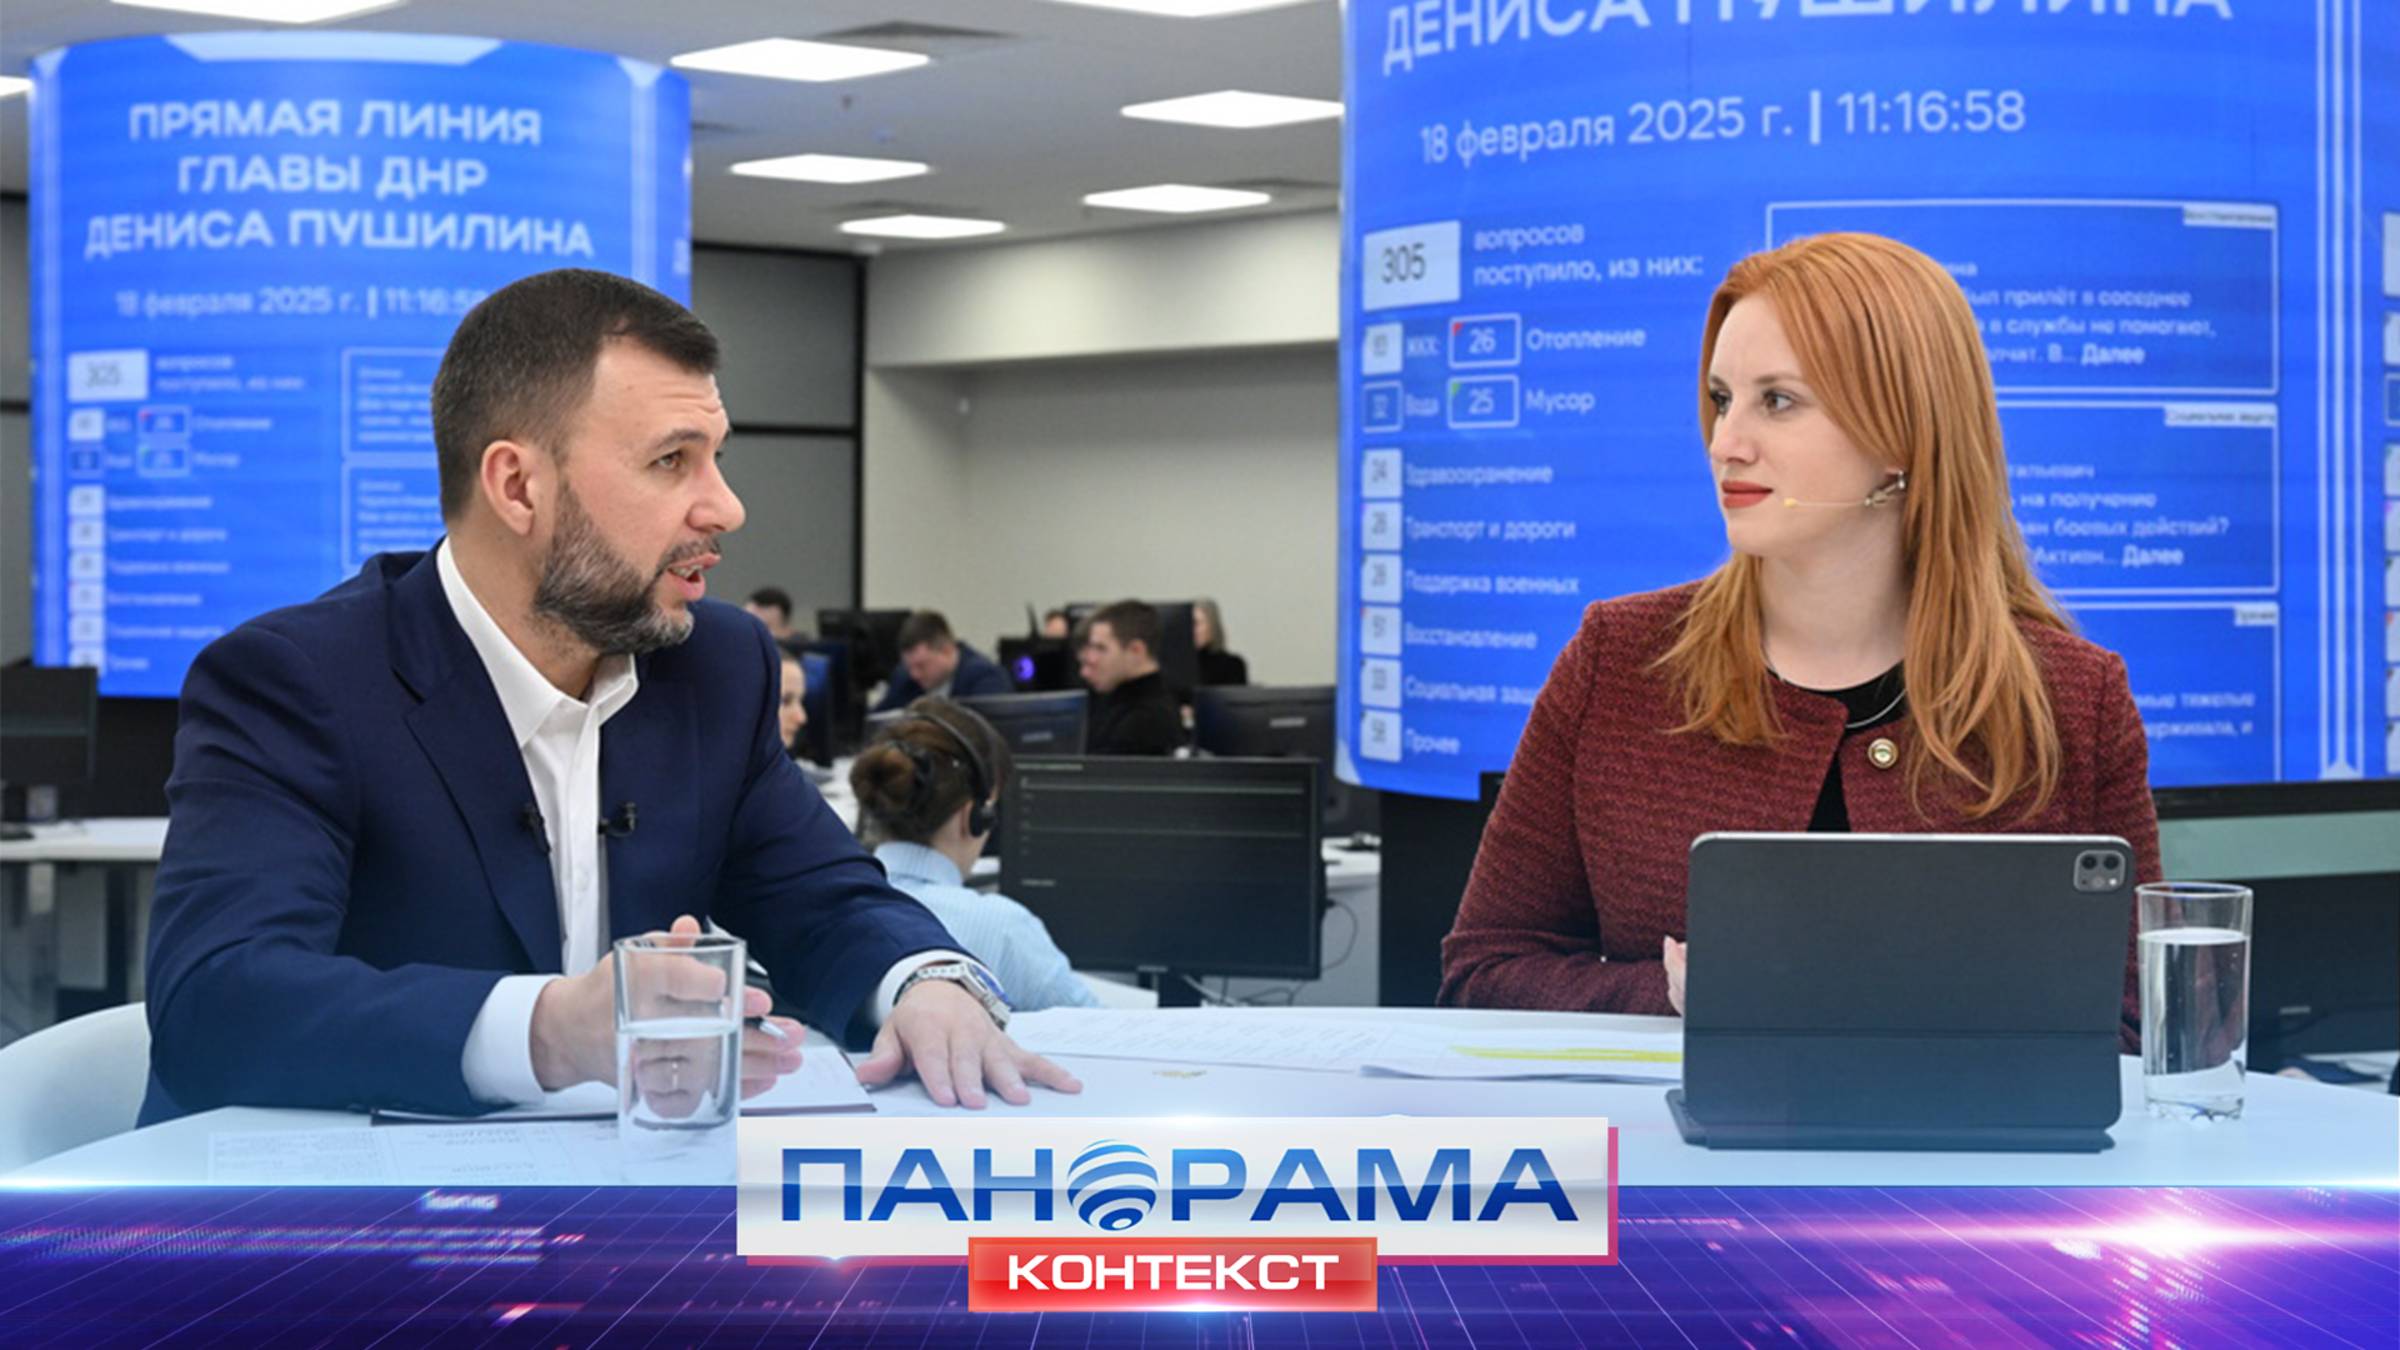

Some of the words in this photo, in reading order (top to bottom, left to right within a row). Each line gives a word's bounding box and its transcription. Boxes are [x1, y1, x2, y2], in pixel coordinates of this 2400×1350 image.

[1383, 0, 1652, 76] ДЕНИСА
[130, 100, 341, 141] ПРЯМАЯ
[357, 102, 542, 146] ЛИНИЯ
[1421, 122, 1447, 164] 18
[1456, 114, 1614, 168] февраля
[1627, 97, 1745, 144] 2025
[1761, 102, 1794, 138] г.
[1836, 89, 2027, 134] 11:16:58
[178, 156, 361, 194] ГЛАВЫ
[375, 157, 487, 199] ДНР
[84, 211, 275, 261] ДЕНИСА
[288, 211, 595, 258] ПУШИЛИНА
[1473, 223, 1586, 251] вопросов
[1380, 241, 1426, 284] 305
[1474, 259, 1602, 289] поступило,
[1609, 259, 1639, 279] из
[1648, 253, 1704, 277] них:
[258, 285, 333, 315] 2025
[1469, 328, 1495, 355] 26
[1525, 326, 1646, 351] Отопление
[2081, 343, 2145, 366] Далее
[1468, 387, 1495, 415] 25
[1525, 389, 1596, 415] Мусор
[2121, 544, 2184, 567] Далее
